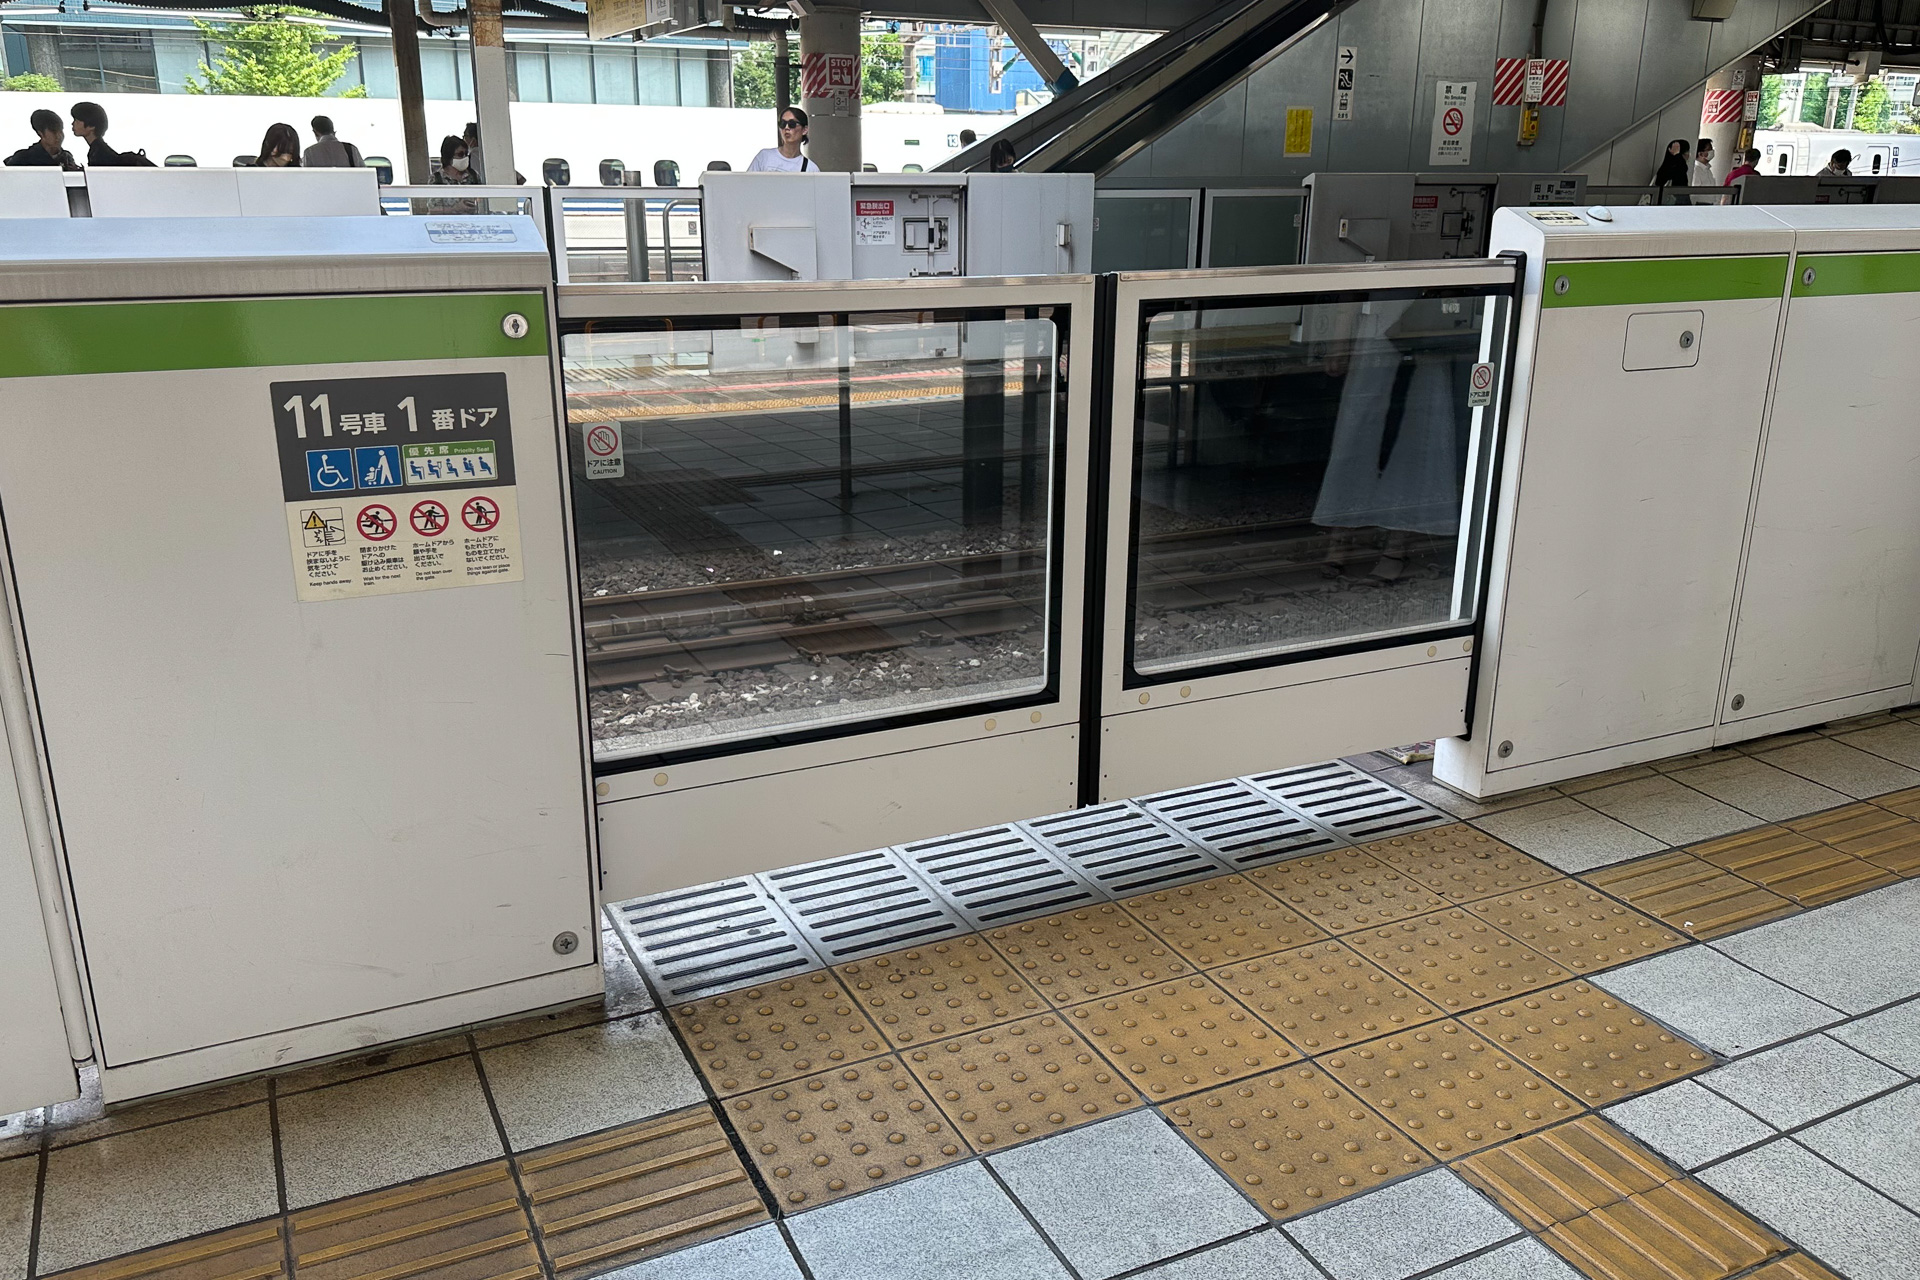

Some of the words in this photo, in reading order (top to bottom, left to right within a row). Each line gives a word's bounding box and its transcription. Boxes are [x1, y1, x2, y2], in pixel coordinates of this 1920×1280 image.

[831, 58, 852, 67] STOP
[1445, 85, 1467, 94] 禁煙
[836, 97, 848, 106] 3-1
[948, 135, 958, 147] 13
[1534, 184, 1554, 194] 田町
[408, 445, 449, 456] 優先席
[587, 458, 621, 467] ドアに注意
[412, 539, 455, 548] ホームドアから
[464, 535, 499, 544] ホームドアに
[306, 550, 337, 558] ドアに手を
[361, 552, 386, 560] ドアへの
[465, 547, 506, 556] ものを立てかけ
[361, 557, 404, 566] 駆け込み乗車は
[413, 553, 444, 562] 出さないで
[307, 563, 339, 572] 気をつけて
